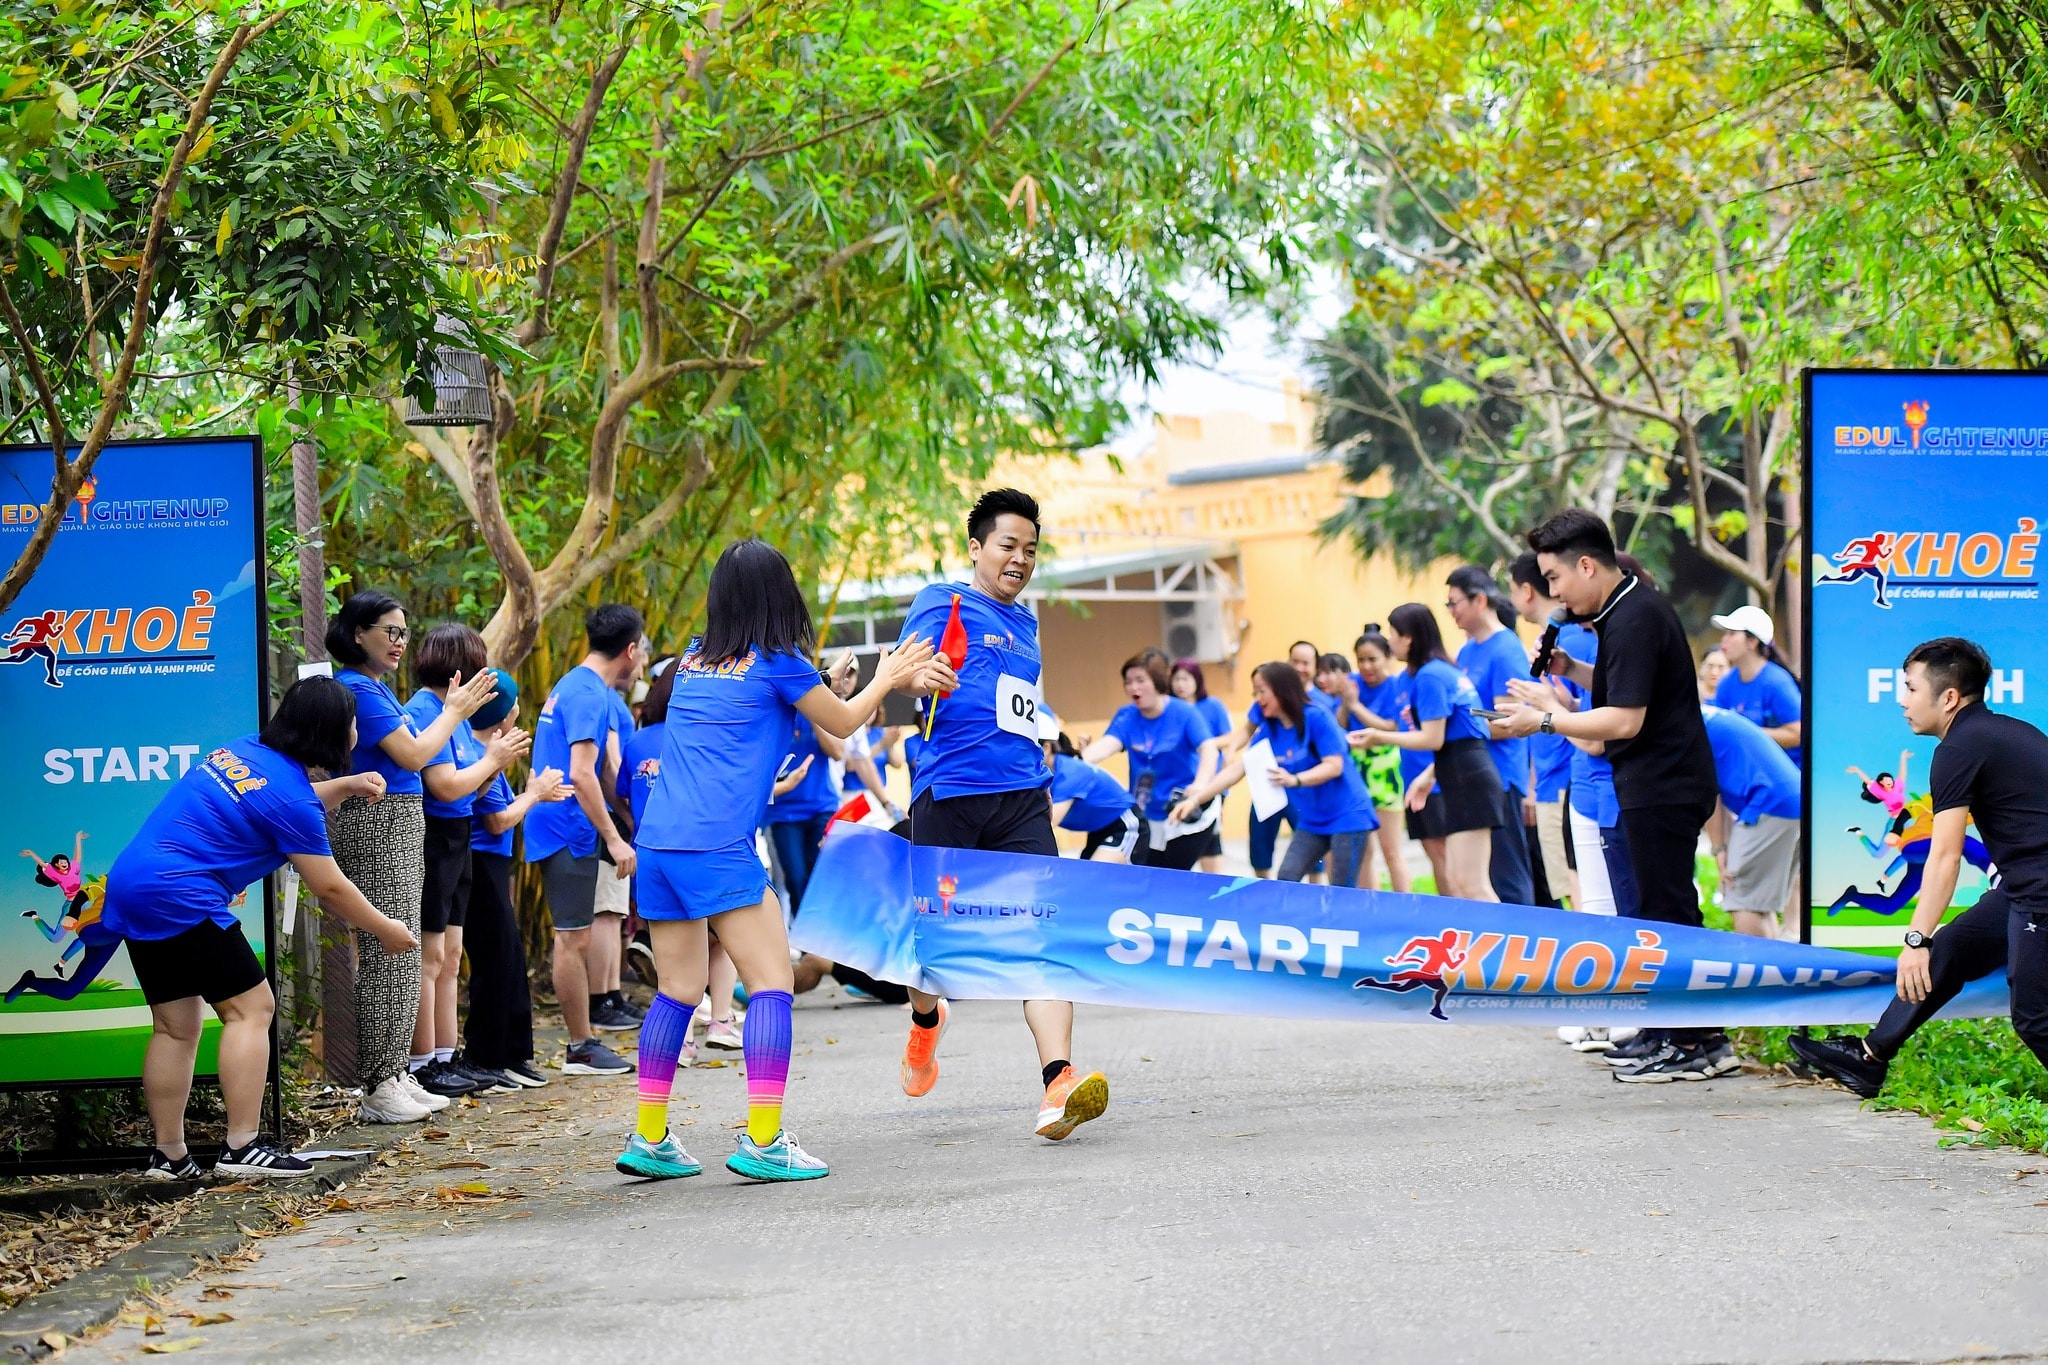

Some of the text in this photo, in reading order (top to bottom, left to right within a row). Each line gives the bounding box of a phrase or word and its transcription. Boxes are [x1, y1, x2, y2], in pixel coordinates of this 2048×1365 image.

[1, 498, 229, 525] EDLIGHTENUP
[49, 589, 216, 655] KHOẺ
[139, 664, 152, 674] VÀ
[186, 662, 215, 673] PHÚC
[1867, 668, 2024, 703] FIH
[1012, 694, 1035, 724] 02
[43, 744, 200, 784] START
[1104, 907, 1360, 979] START
[1445, 929, 1668, 993] KHOẺ
